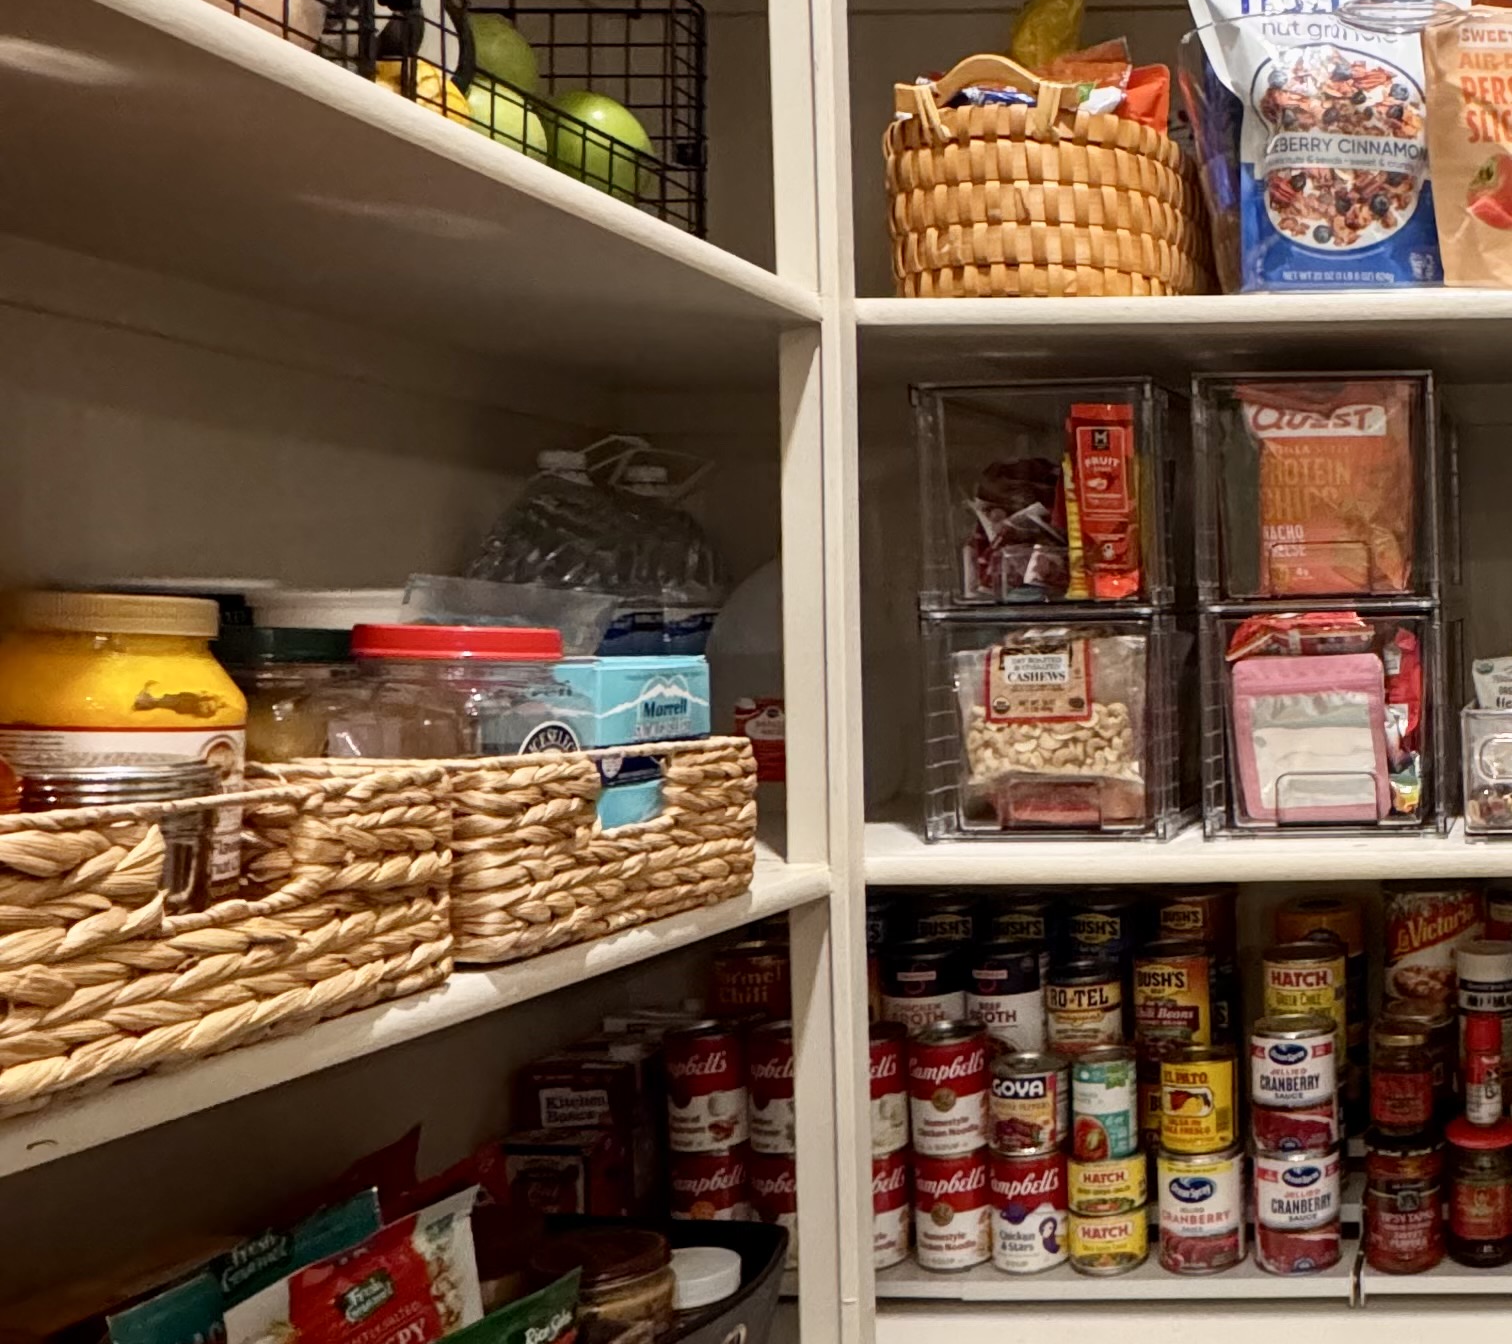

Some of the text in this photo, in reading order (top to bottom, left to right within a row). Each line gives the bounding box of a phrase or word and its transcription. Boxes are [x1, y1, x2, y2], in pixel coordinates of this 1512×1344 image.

[1262, 20, 1300, 36] nut
[1273, 137, 1334, 153] EBERRY
[1084, 456, 1121, 468] FRUIT
[1007, 671, 1066, 682] CASHEWS
[643, 699, 688, 718] Morrell
[1271, 971, 1328, 987] HATCH
[909, 1049, 985, 1086] Campbell's
[1270, 1067, 1308, 1075] JELLIED
[1175, 1071, 1208, 1084] PATO
[1260, 1074, 1320, 1092] CRANBERRY
[993, 1080, 1044, 1097] GOYA
[673, 1161, 748, 1197] ampbell's
[1083, 1171, 1125, 1183] HATCH
[1271, 1193, 1331, 1215] CRANBERRY
[1162, 1209, 1232, 1225] CRANBERRY
[1288, 1213, 1318, 1222] SAUCE
[1081, 1225, 1128, 1239] HATCH
